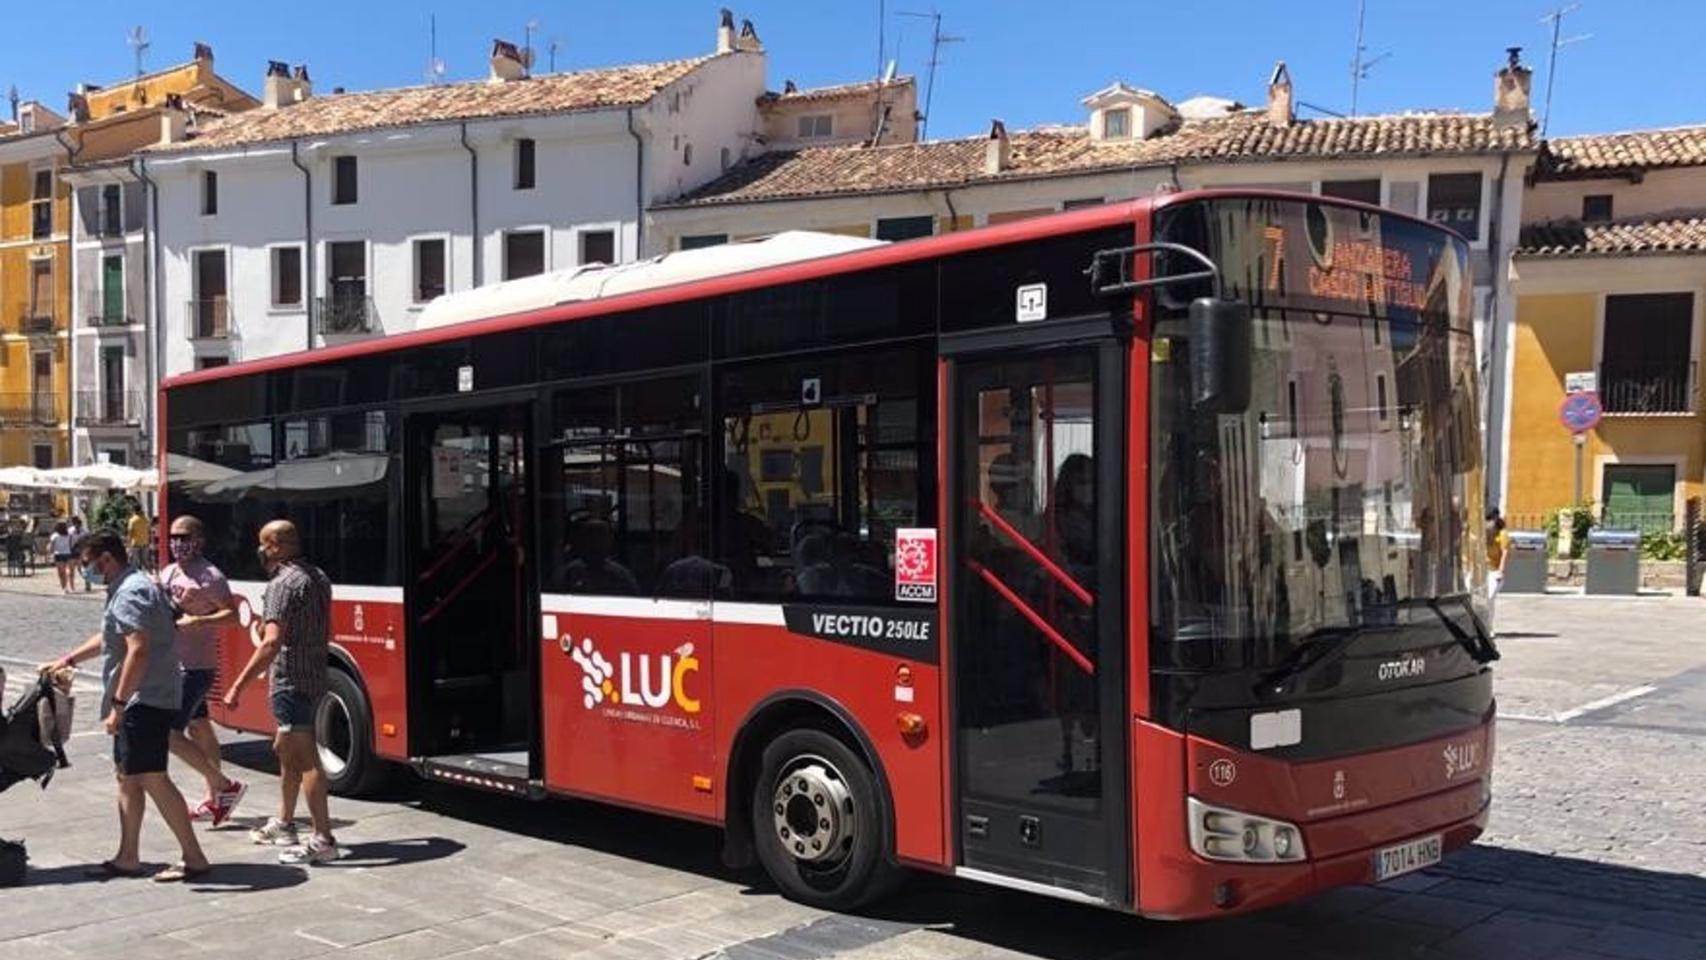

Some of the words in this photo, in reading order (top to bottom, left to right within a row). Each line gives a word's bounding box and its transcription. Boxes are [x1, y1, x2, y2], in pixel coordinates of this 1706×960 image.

[1264, 226, 1285, 290] 7
[901, 585, 932, 597] ACCM
[812, 614, 884, 637] VECTIO
[886, 620, 930, 640] 250LE
[621, 650, 700, 712] LUC
[1379, 658, 1425, 680] OTOKAR
[1214, 764, 1232, 781] 116
[1383, 846, 1415, 875] 7014
